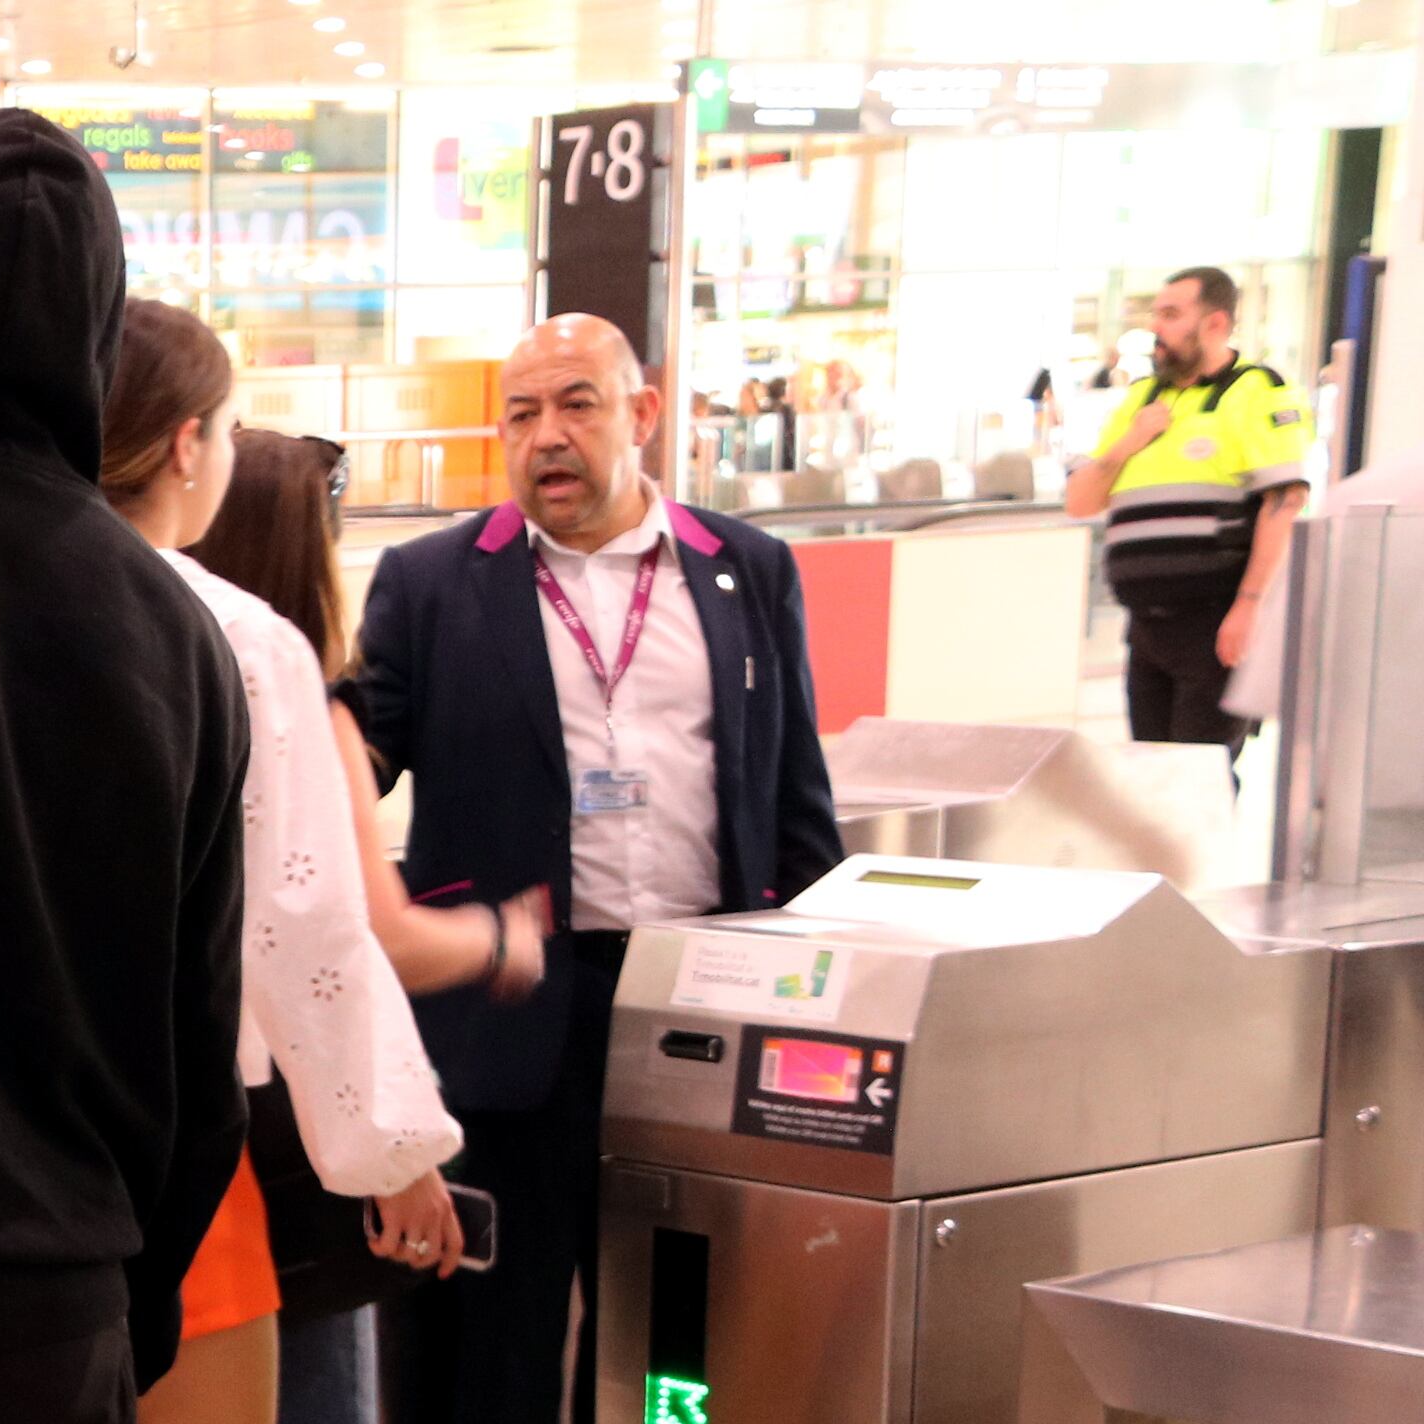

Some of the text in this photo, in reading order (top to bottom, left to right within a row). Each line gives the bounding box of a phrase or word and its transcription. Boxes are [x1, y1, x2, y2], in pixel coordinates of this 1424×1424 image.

[83, 124, 151, 152] regals
[122, 150, 203, 171] take awa
[554, 598, 581, 629] renfe
